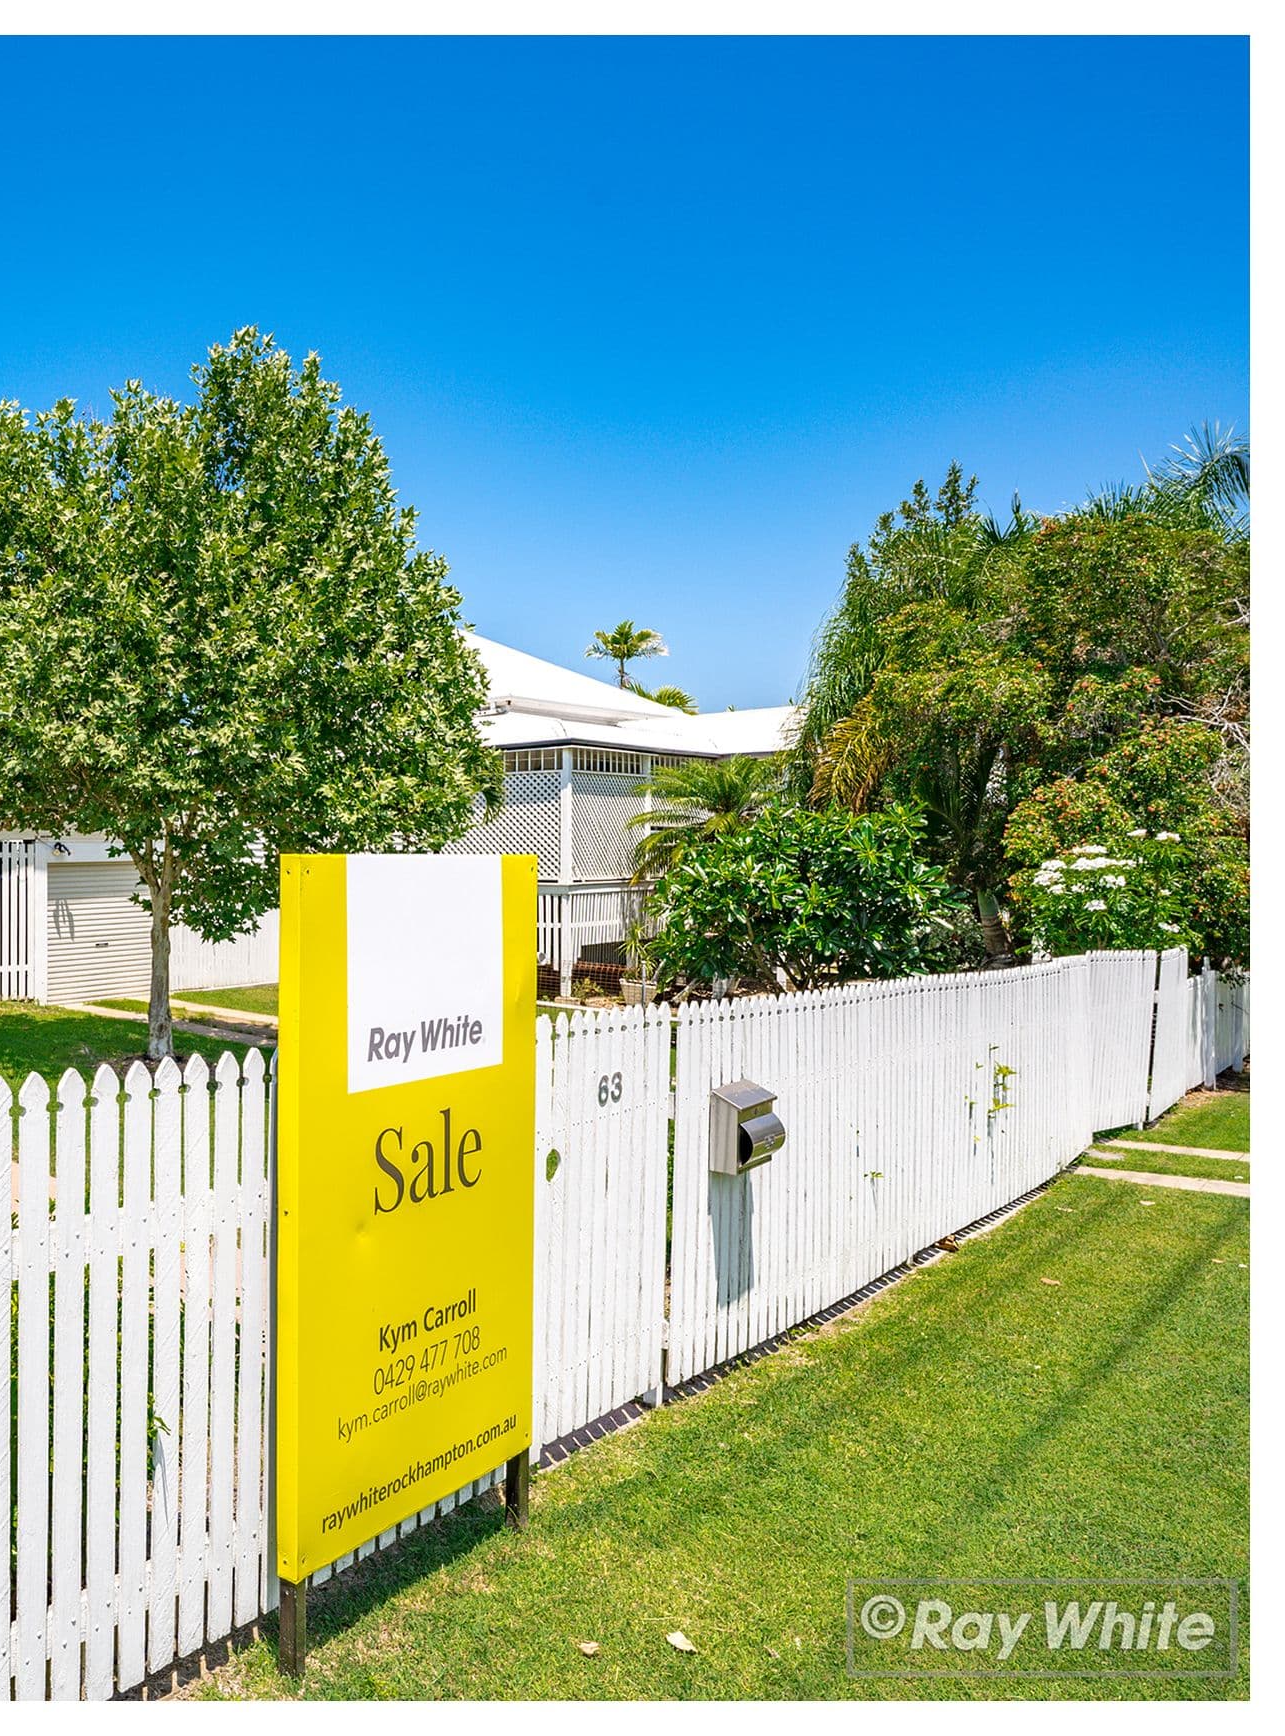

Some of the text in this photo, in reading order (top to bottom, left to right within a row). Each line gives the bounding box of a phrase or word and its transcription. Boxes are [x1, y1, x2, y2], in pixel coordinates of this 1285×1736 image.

[367, 1014, 483, 1063] Ray White
[598, 1071, 623, 1107] 63
[374, 1107, 482, 1215] Sale
[379, 1288, 477, 1354] Kym Carroll
[338, 1346, 507, 1443] kym.carroll@raywhite.com
[373, 1326, 481, 1395] 0429 477 708
[321, 1414, 517, 1533] raywhiterockhampton.com.au
